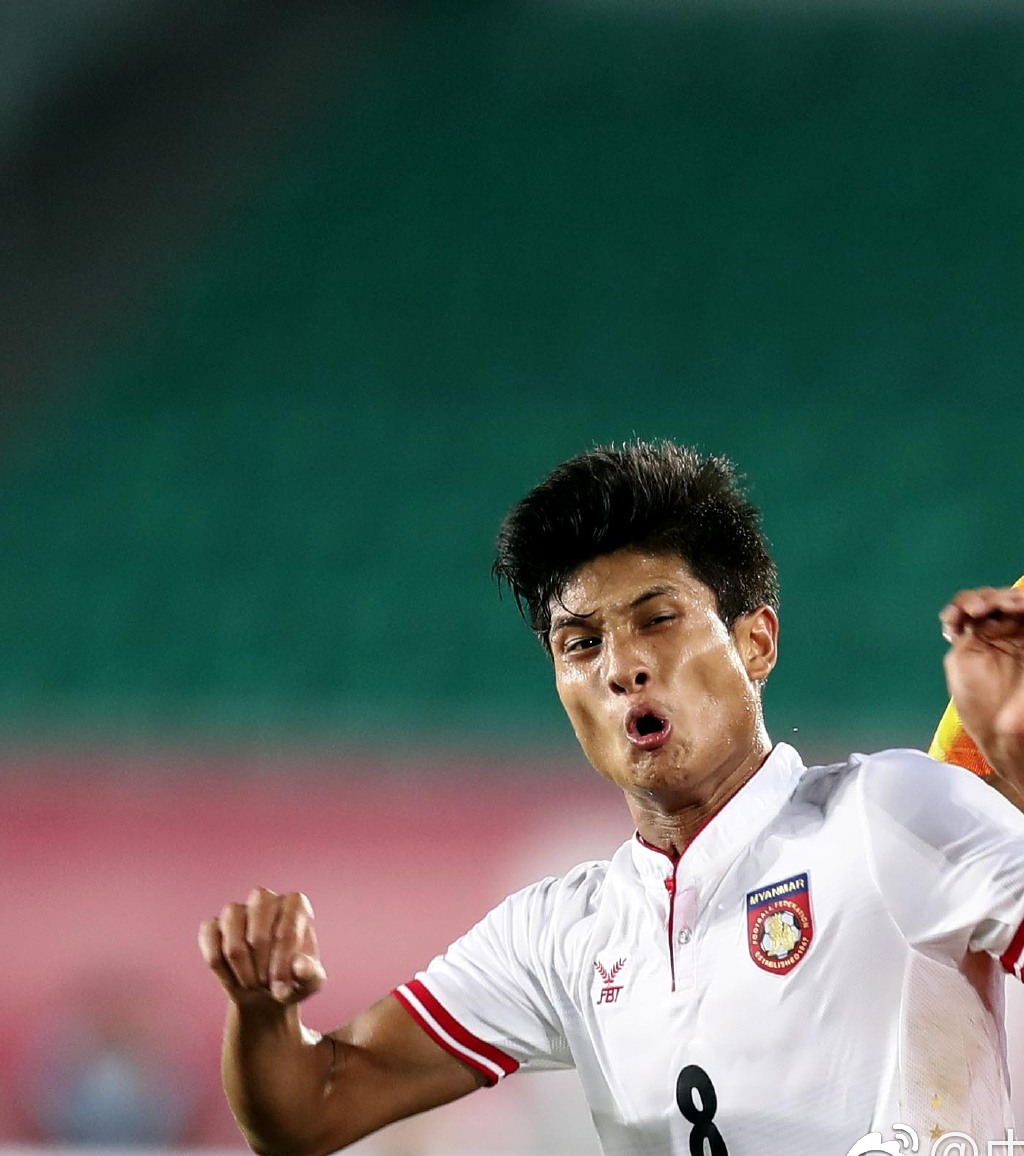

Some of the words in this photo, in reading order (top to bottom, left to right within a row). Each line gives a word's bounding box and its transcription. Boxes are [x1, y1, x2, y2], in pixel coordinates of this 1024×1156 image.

[749, 879, 805, 905] MYANMAR
[755, 950, 800, 969] ESTABLISHED
[596, 985, 624, 1005] FBT
